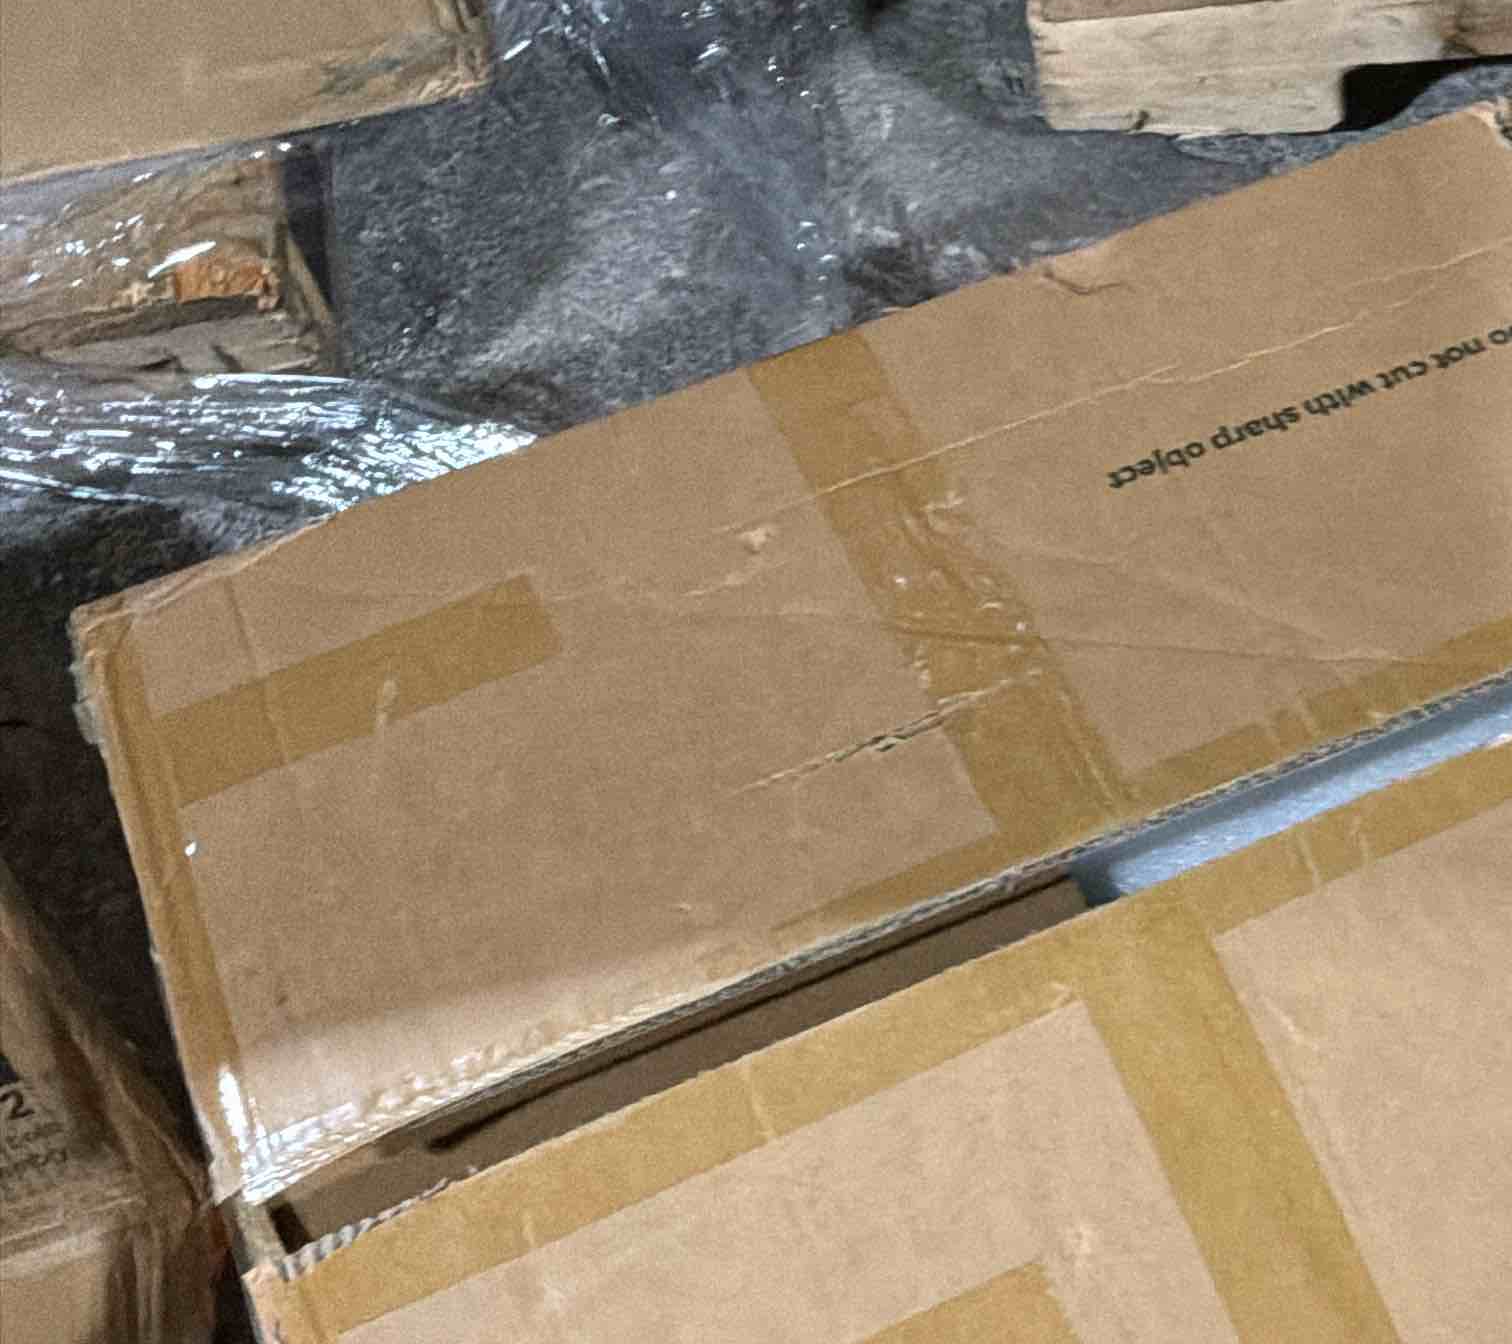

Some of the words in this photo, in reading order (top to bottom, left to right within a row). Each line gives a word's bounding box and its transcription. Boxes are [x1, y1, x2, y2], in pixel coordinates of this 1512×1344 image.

[1380, 357, 1430, 390] cut
[1428, 334, 1487, 370] not
[1304, 373, 1378, 416] with
[1210, 403, 1302, 452] sharp
[1107, 439, 1206, 490] object
